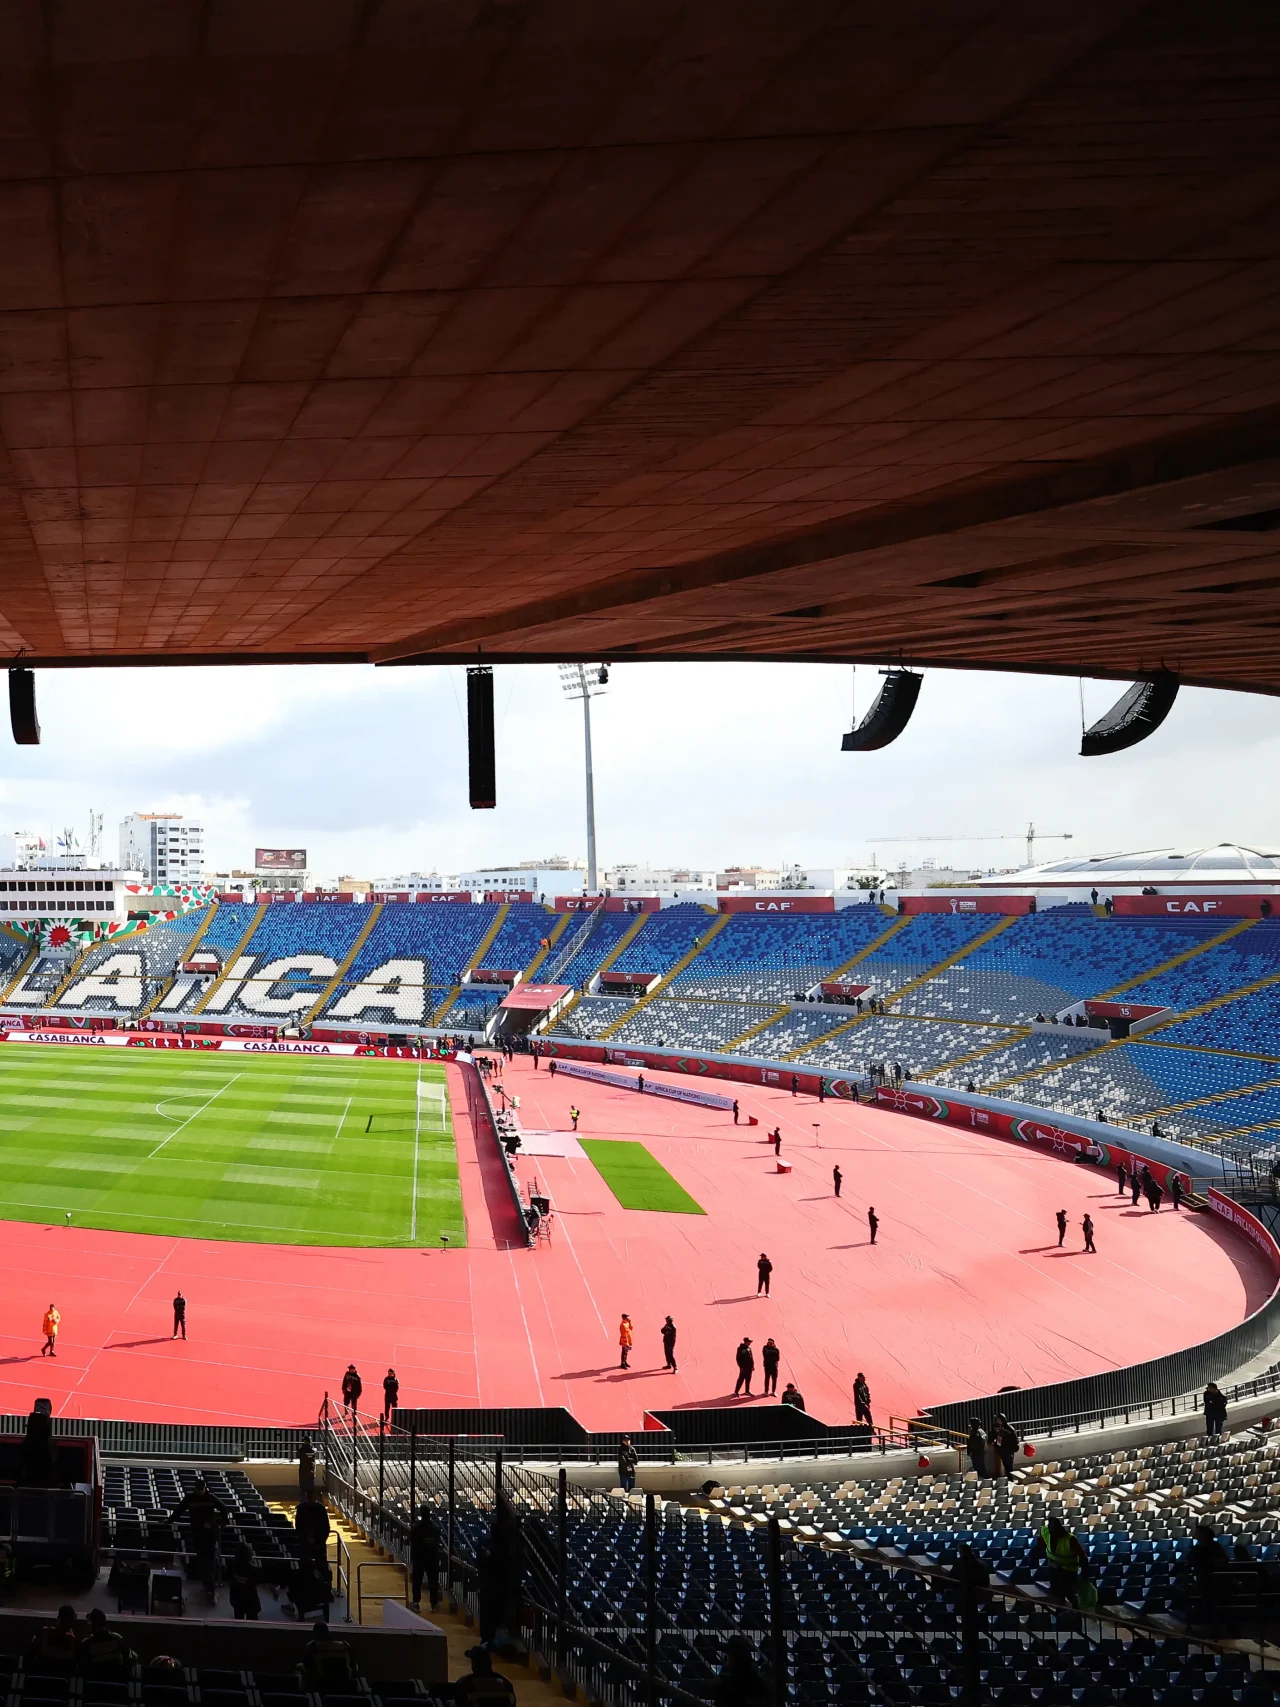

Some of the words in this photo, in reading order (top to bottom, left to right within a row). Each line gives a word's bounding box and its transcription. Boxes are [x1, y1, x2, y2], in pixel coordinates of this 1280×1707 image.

[755, 902, 791, 911] CAF
[1166, 901, 1217, 913] CAF
[1120, 1007, 1130, 1016] 15
[28, 1033, 106, 1044] CASABLANCA
[243, 1042, 330, 1053] CASABLANCA
[655, 1085, 668, 1093] AFRICA
[683, 1091, 701, 1100] NATIONS
